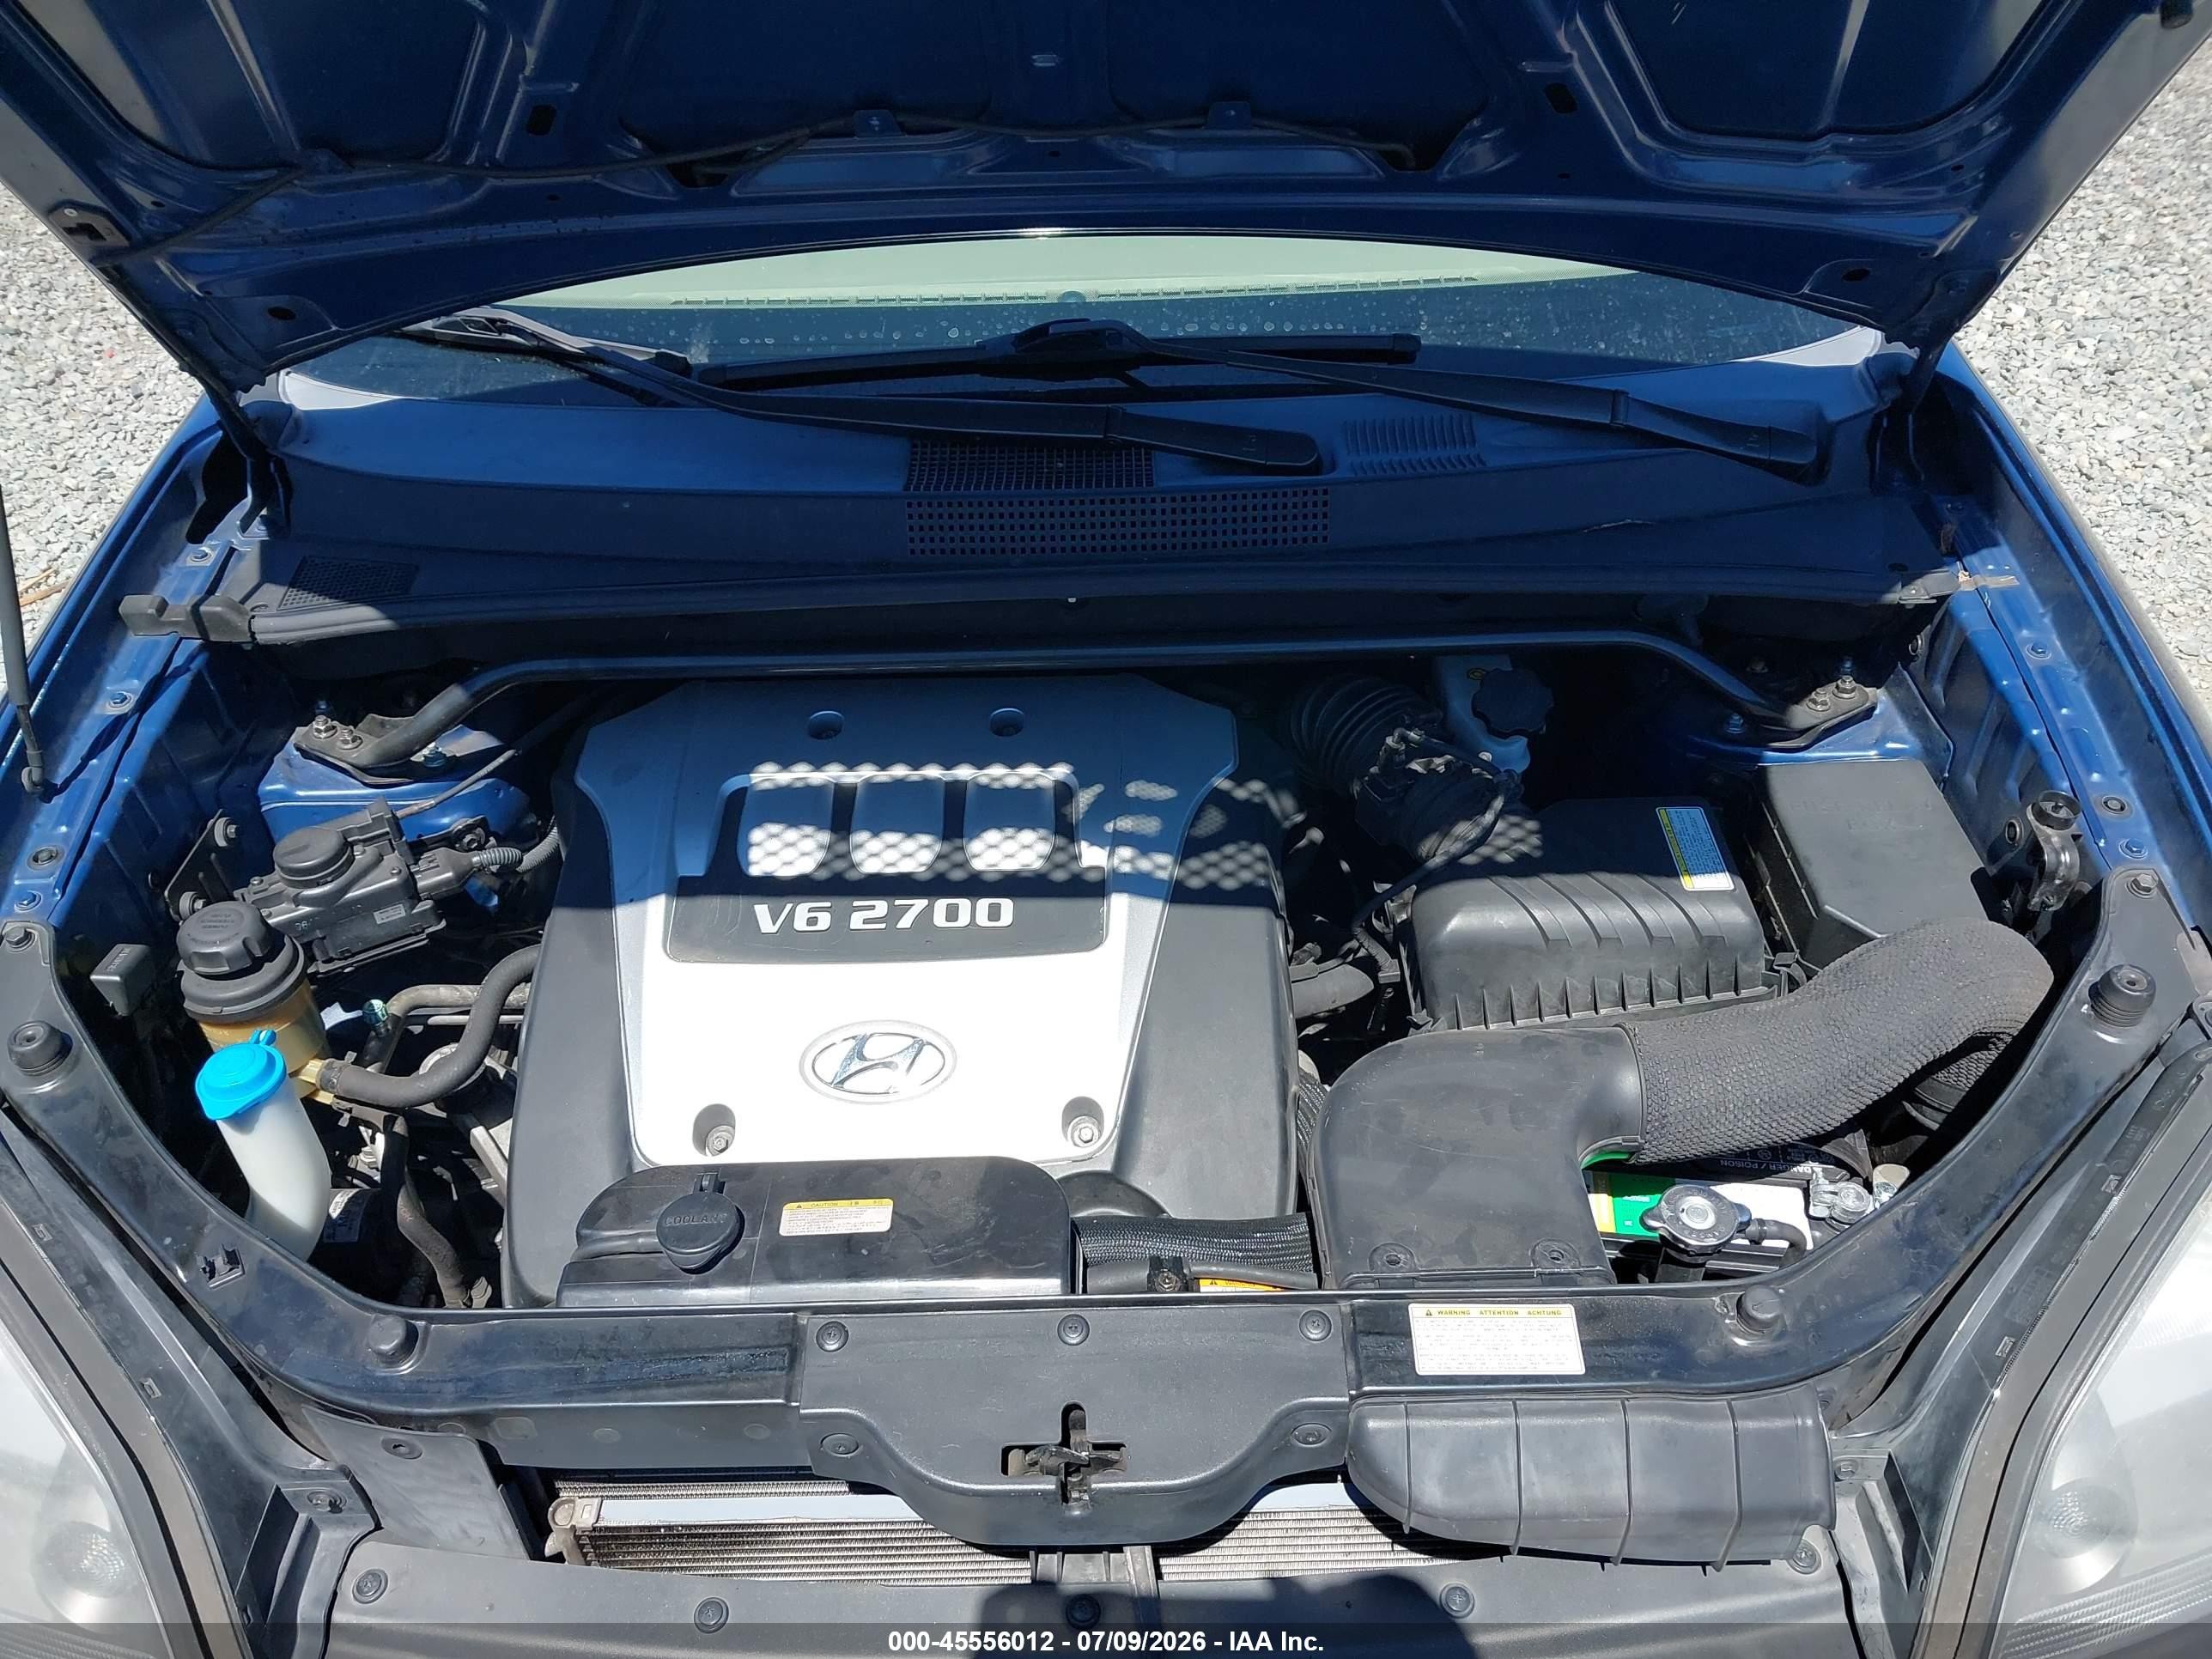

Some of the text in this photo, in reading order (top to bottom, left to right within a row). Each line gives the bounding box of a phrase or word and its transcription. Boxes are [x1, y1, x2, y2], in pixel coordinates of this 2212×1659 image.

[754, 898, 1014, 933] V6 2700
[1719, 1159, 1759, 1169] POISON
[1769, 1162, 1812, 1174] DANGER
[665, 1212, 728, 1227] COOLANT
